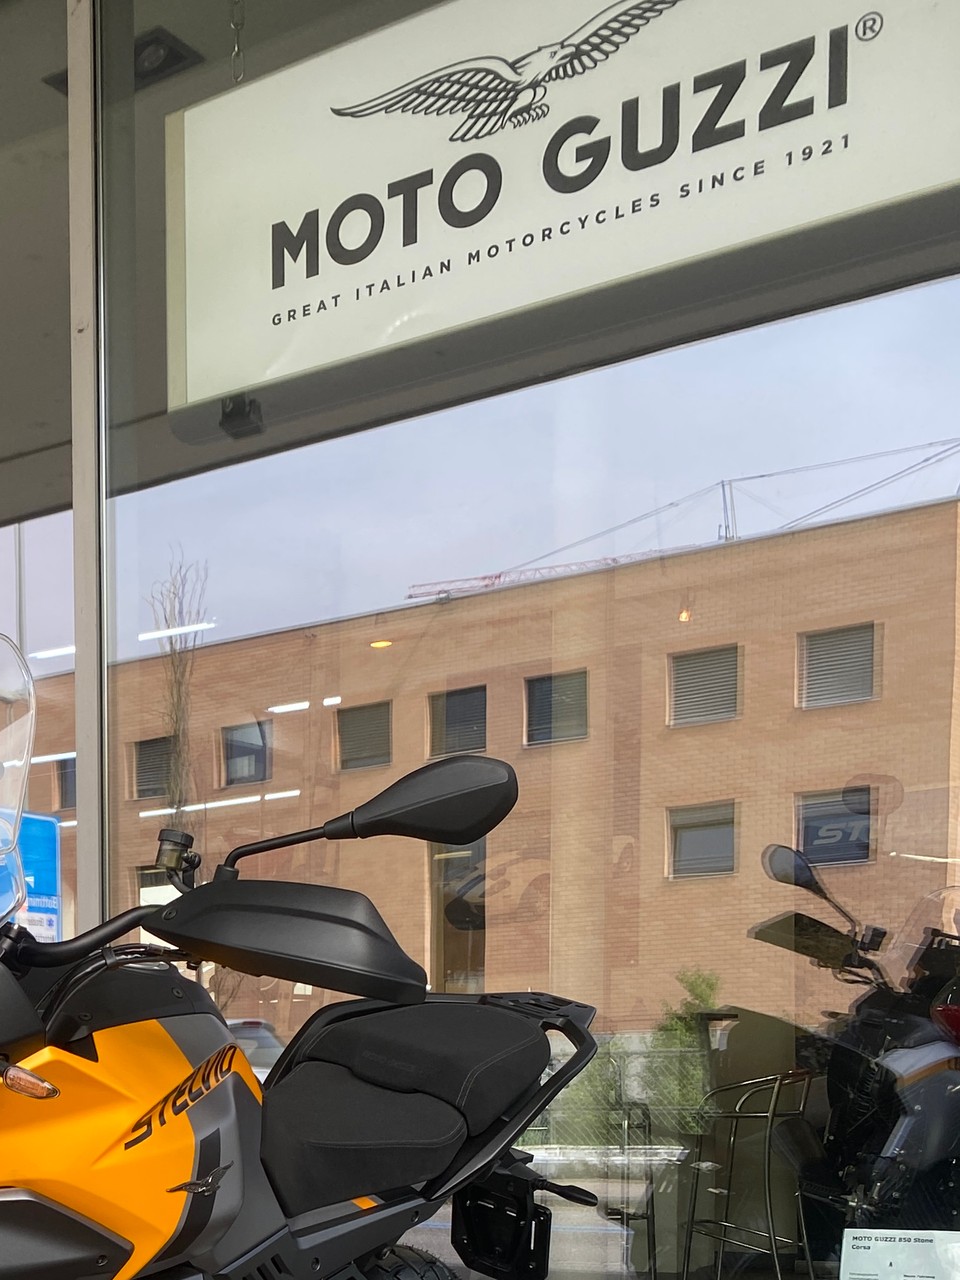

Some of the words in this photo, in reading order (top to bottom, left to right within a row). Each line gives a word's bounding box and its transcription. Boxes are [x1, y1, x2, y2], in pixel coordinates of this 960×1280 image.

[270, 152, 503, 290] MOTO
[271, 294, 342, 326] GREAT
[355, 258, 453, 300] ITALIAN
[467, 193, 662, 265] MOTORCYCLES
[679, 158, 766, 198] SINCE
[784, 133, 852, 166] 1921
[124, 1045, 237, 1151] STELVIO
